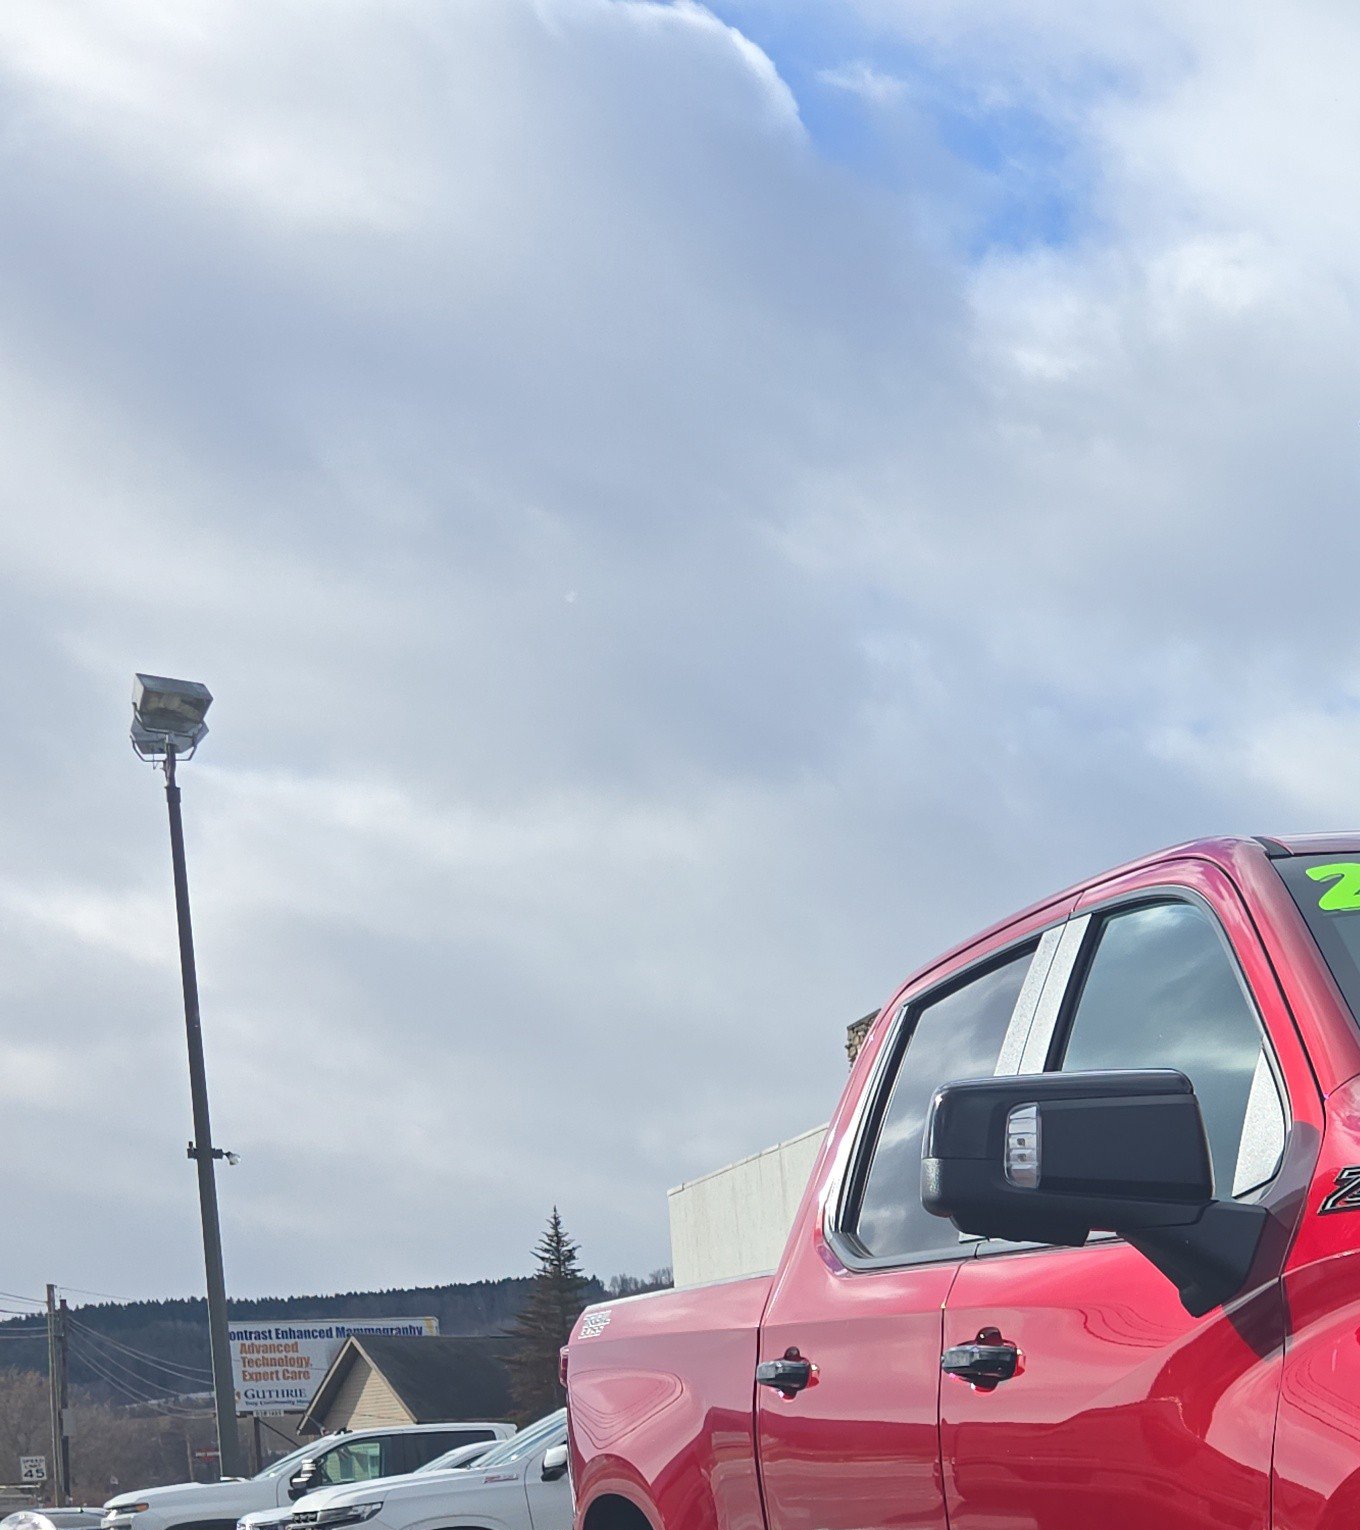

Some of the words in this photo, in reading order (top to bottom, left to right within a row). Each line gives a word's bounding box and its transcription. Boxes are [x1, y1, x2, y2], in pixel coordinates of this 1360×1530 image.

[228, 1328, 273, 1341] ontrast
[275, 1326, 333, 1340] Enhanced
[240, 1341, 299, 1354] Advanced
[242, 1368, 280, 1382] Expert
[282, 1368, 311, 1380] Care
[24, 1469, 45, 1479] 45
